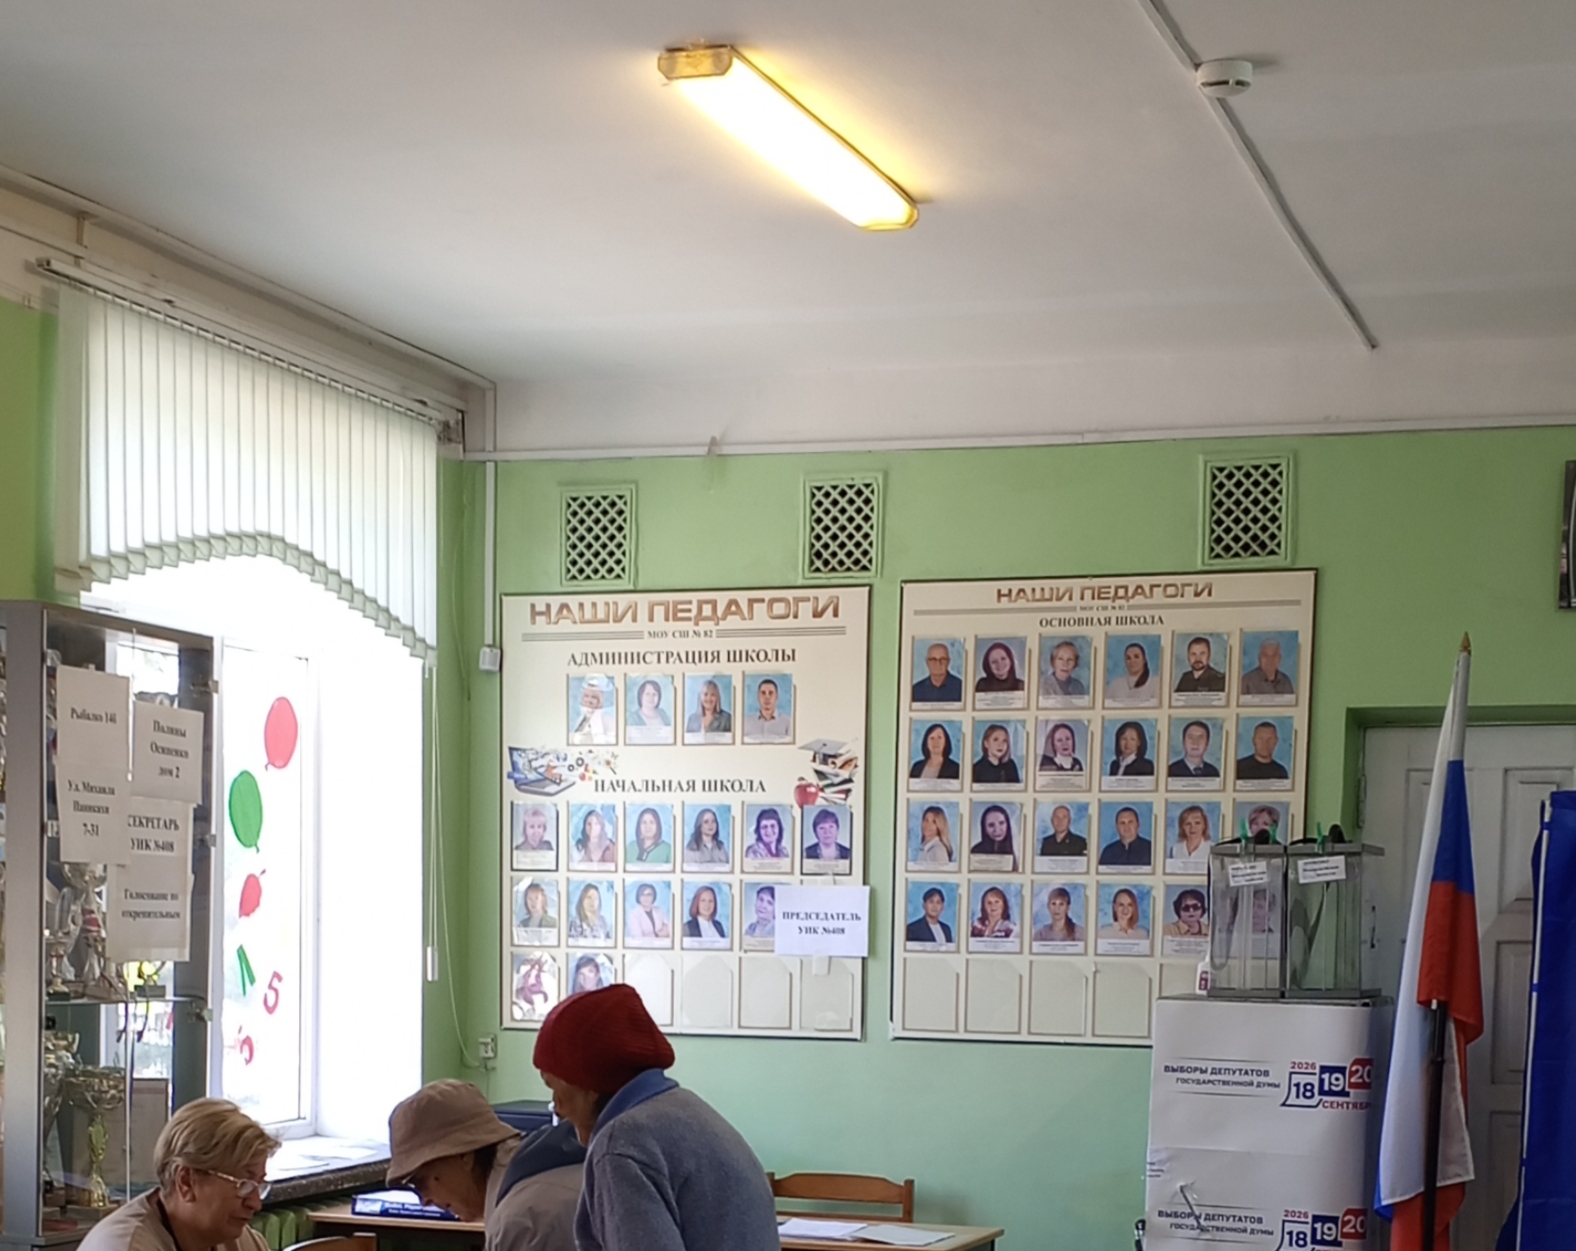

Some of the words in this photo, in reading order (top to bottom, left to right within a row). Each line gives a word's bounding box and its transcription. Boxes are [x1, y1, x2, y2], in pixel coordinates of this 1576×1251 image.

[996, 586, 1074, 604] НАШИ
[1080, 582, 1213, 603] ПЕДАГОГИ
[530, 600, 638, 626] НАШИ
[648, 596, 840, 626] ПЕДАГОГИ
[1039, 616, 1112, 629] ОСНОВНАЯ
[1115, 614, 1165, 626] ШКОЛА
[647, 630, 669, 640] МОУ
[672, 629, 690, 639] СШ
[703, 629, 714, 639] 82
[567, 650, 721, 668] АДМИНИСТРАЦИЯ
[726, 648, 797, 663] ШКОЛЫ
[175, 766, 180, 778] 2
[594, 779, 697, 793] НАЧАЛЬНАЯ
[701, 779, 766, 793] ШКОЛА
[127, 814, 180, 831] СЕКРЕТАРЬ
[130, 837, 152, 851] УИК
[782, 911, 862, 922] ПРЕДСЕДАТЕЛЬ
[798, 926, 819, 935] УИК
[1163, 1064, 1209, 1075] ВЫБОРЫ
[1209, 1066, 1270, 1078] ДЕПУТАТОВ
[1290, 1061, 1317, 1071] 2026
[1175, 1077, 1255, 1087] ГОСУДАРСТВЕННОЙ
[1255, 1080, 1281, 1089] ДУМЫ
[1292, 1081, 1316, 1100] 18
[1320, 1072, 1345, 1092] 19
[1350, 1064, 1373, 1083] 20
[1321, 1100, 1371, 1111] СЕНТЯБР
[1157, 1209, 1203, 1220] ВЫБОРЫ
[1203, 1212, 1264, 1225] ДЕПУТАТОВ
[1283, 1209, 1310, 1219] 2026
[1248, 1227, 1275, 1236] ДУМЫ
[1286, 1229, 1308, 1248] 18
[1313, 1222, 1338, 1241] 19
[1342, 1214, 1366, 1233] 20
